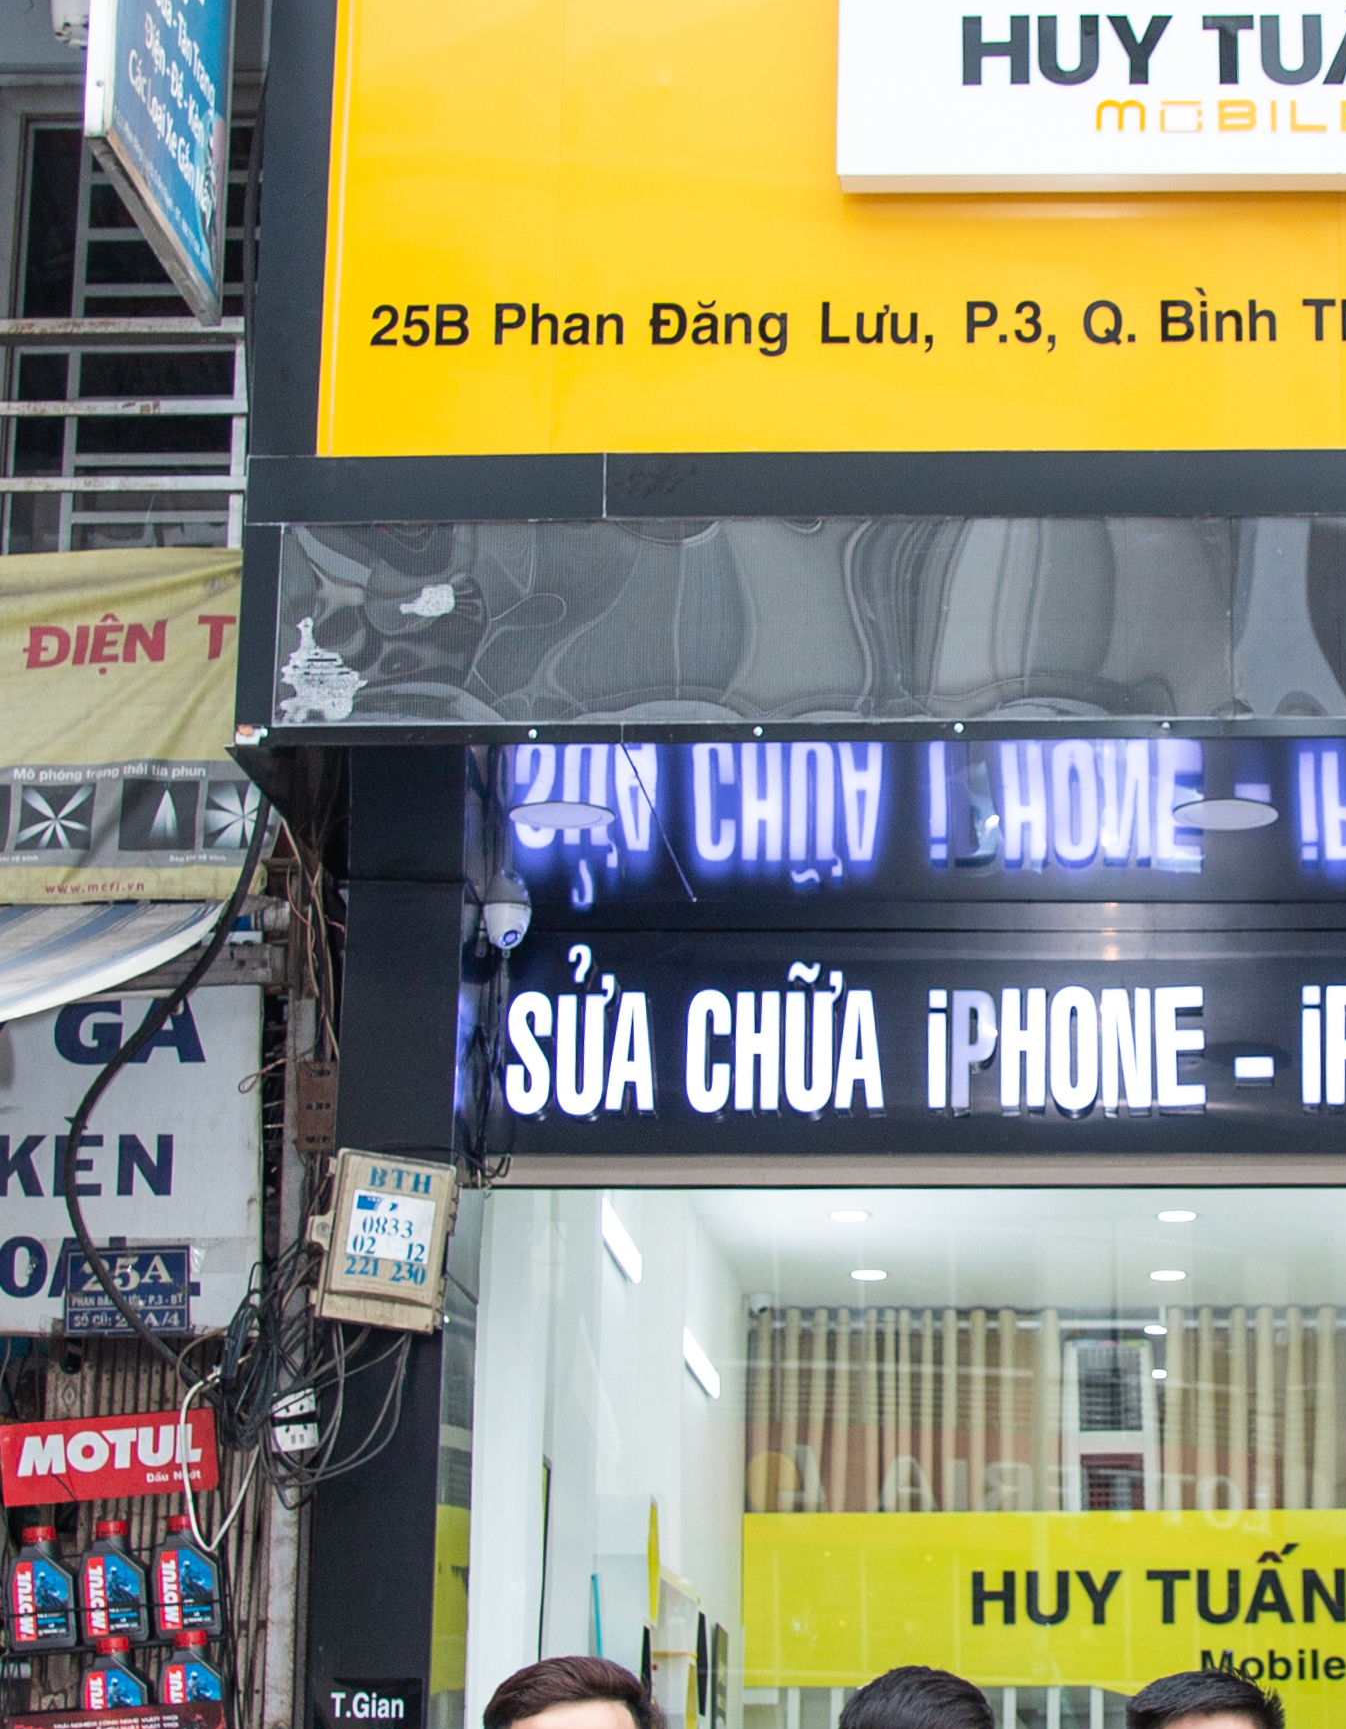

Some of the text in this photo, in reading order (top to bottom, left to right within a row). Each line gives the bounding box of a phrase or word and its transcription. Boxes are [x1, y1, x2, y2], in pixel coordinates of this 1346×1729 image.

[962, 15, 1172, 85] HUY
[370, 304, 469, 347] 25B
[495, 303, 623, 345] Phan
[649, 300, 787, 356] Đăng
[821, 302, 933, 352] Lưu,
[967, 301, 1055, 352] P.3,
[1083, 300, 1135, 345] Q.
[1161, 287, 1276, 342] Bình
[23, 613, 168, 675] ĐIỆN
[171, 766, 207, 781] phun
[505, 944, 655, 1116] SỬA
[685, 962, 884, 1114] CHỮA
[927, 985, 1206, 1114] iPHONE
[352, 1234, 426, 1263] 02 12
[362, 1216, 414, 1239] 0833
[345, 1256, 427, 1286] 221 230
[17, 1424, 203, 1478] MOTUL
[972, 1543, 1346, 1625] HUY TUẤN
[1200, 1649, 1346, 1682] Mobile
[330, 1691, 405, 1719] T.Gian
